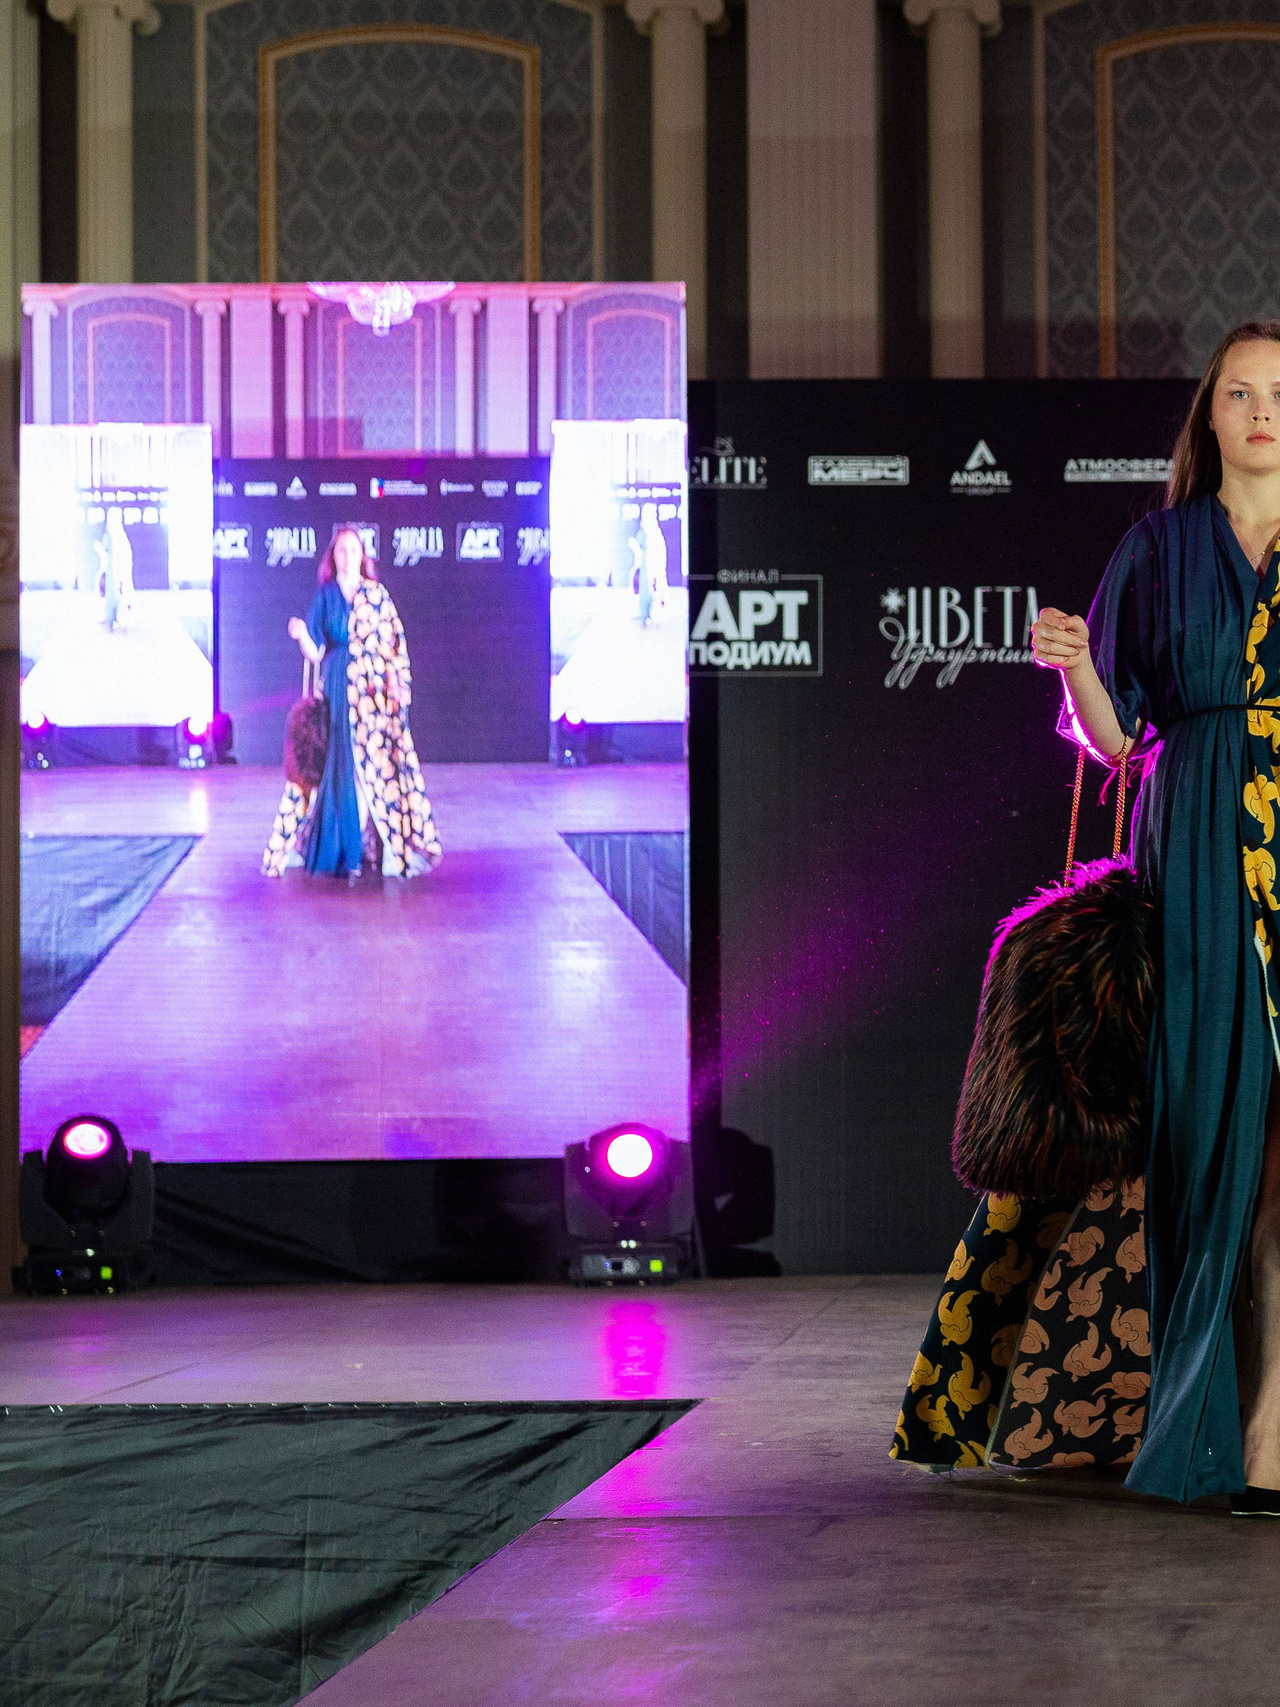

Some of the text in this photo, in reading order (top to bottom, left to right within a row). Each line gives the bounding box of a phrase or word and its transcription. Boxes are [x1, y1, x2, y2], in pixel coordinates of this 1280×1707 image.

[814, 467, 904, 482] МЕРЧ
[949, 470, 1012, 486] ANDAEL
[716, 569, 779, 584] ФИНАЛ
[690, 590, 809, 640] АРТ
[689, 641, 812, 670] ПОДИУМ
